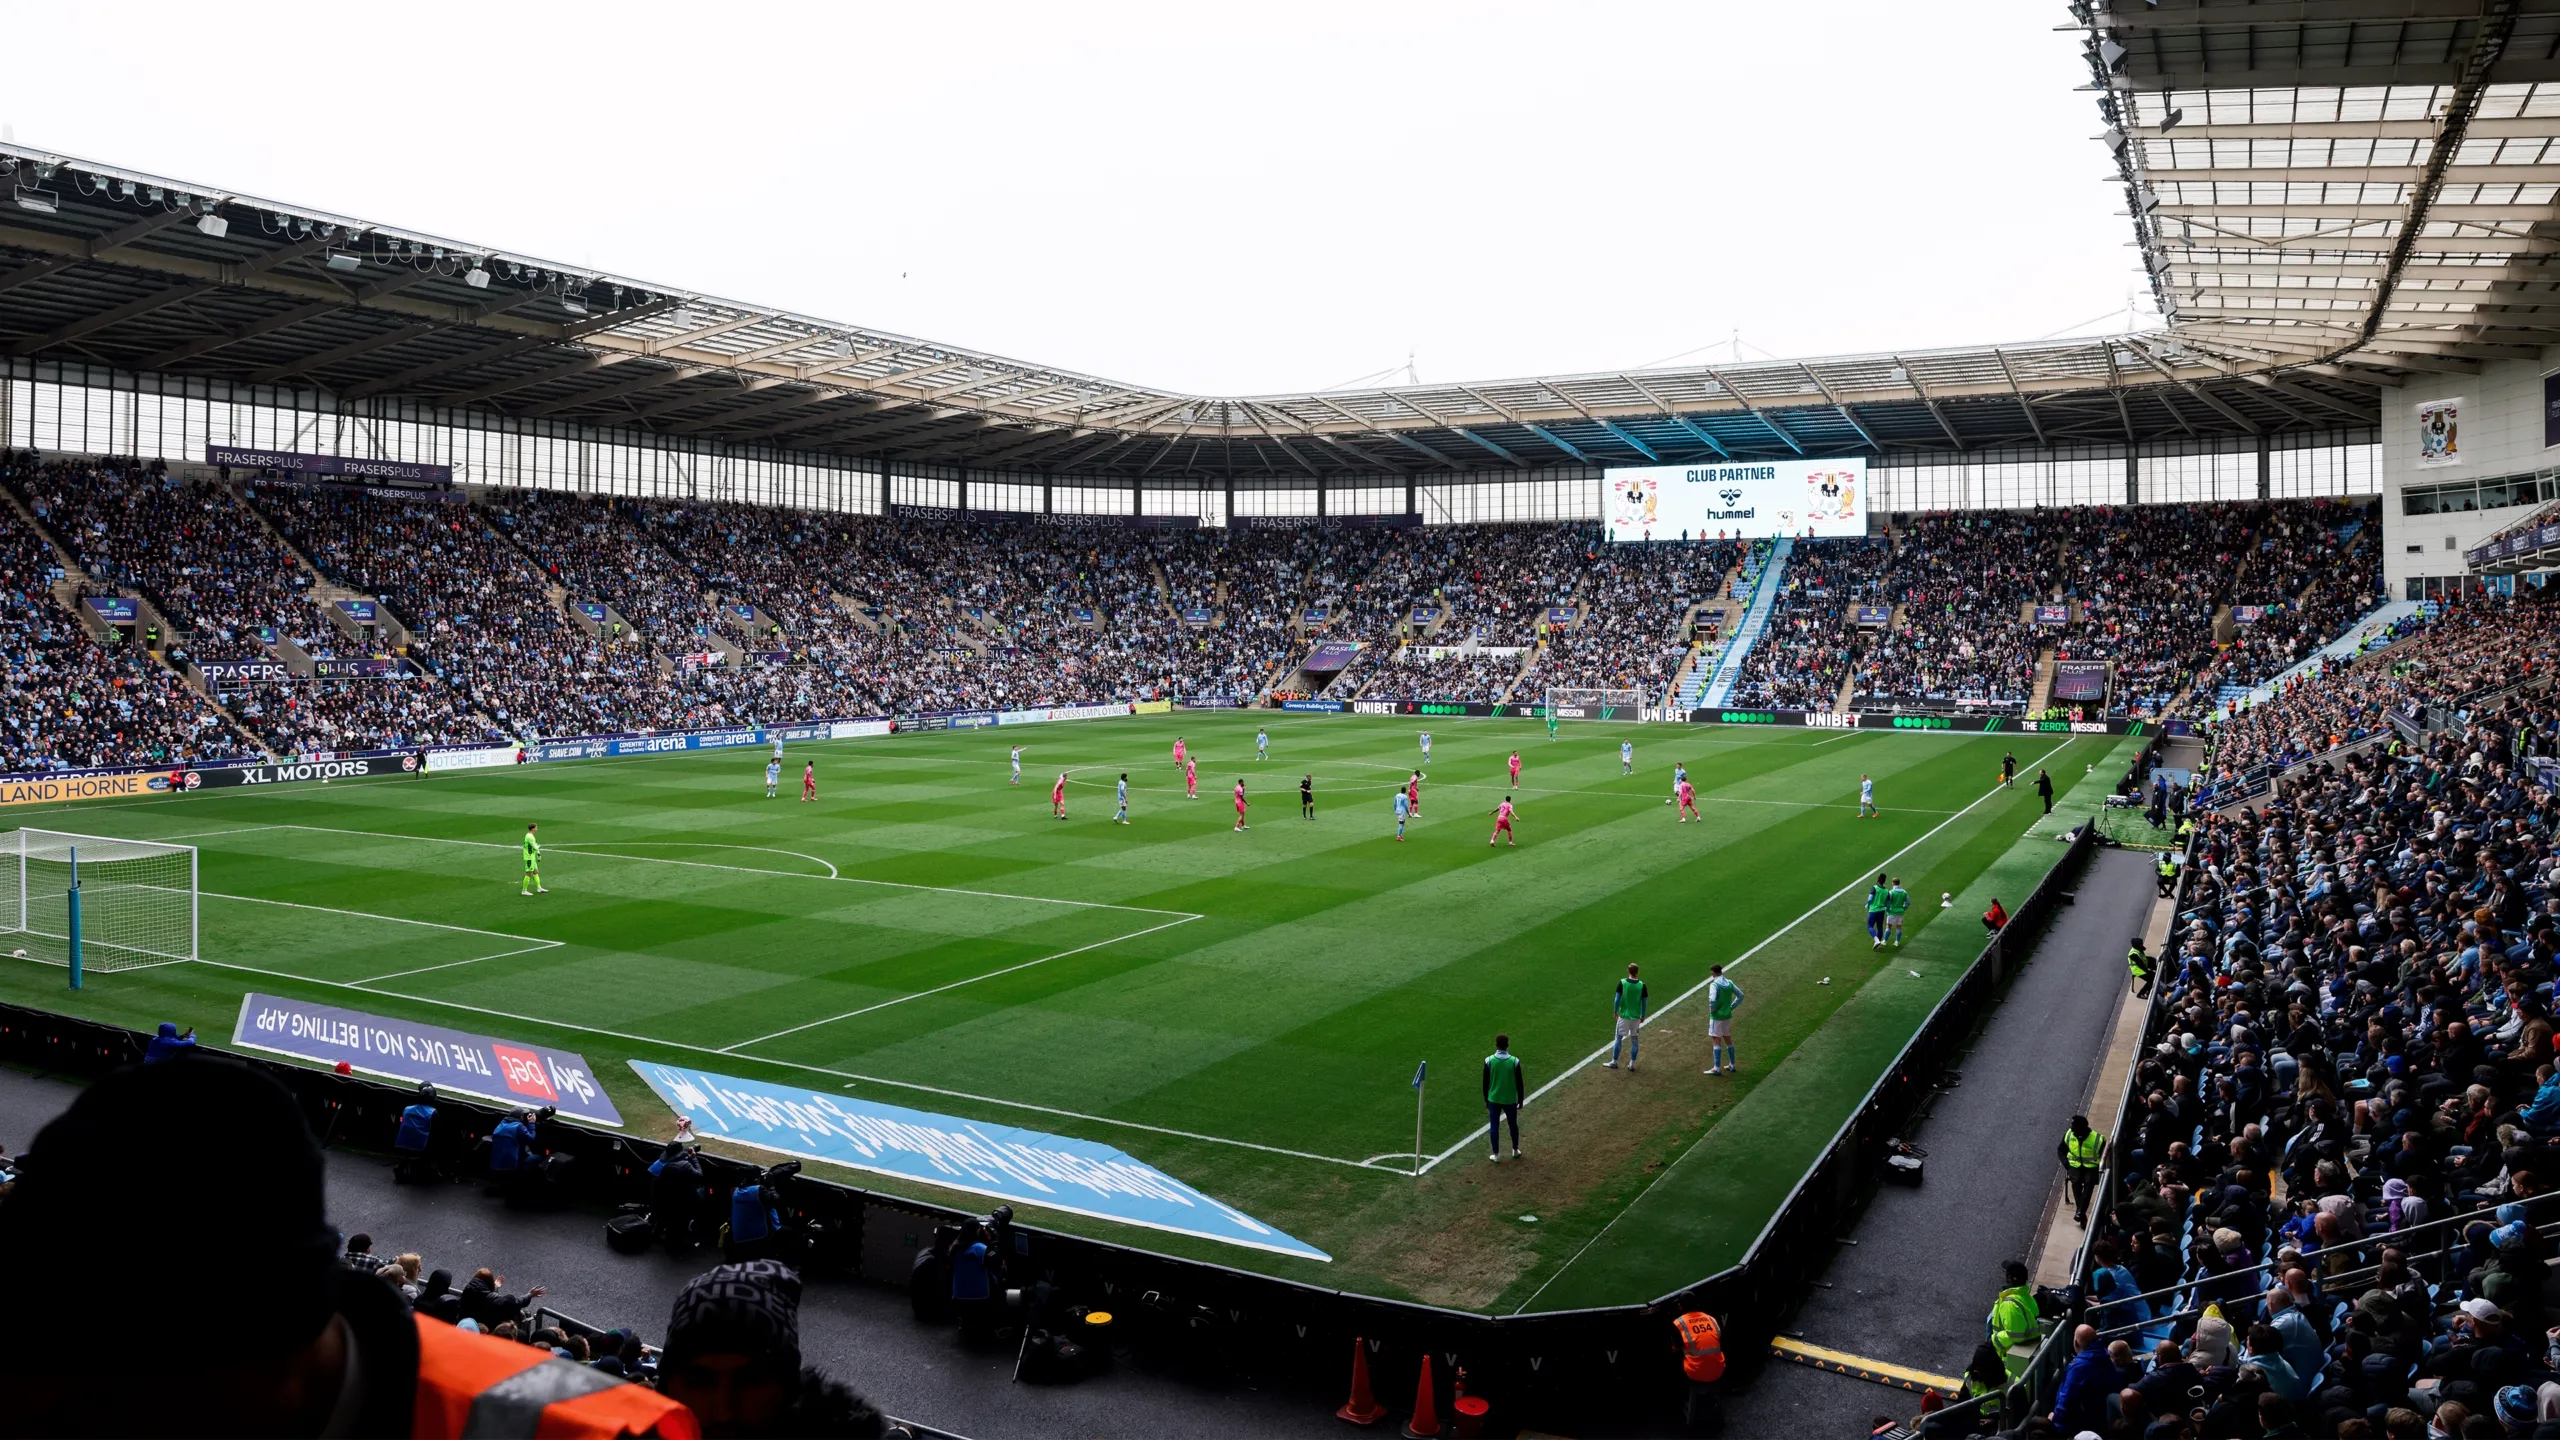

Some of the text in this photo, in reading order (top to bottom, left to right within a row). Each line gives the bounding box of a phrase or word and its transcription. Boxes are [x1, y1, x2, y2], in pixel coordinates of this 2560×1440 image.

[216, 451, 303, 469] FRASERSPLUS
[344, 462, 421, 478] FRASERSPLUS
[1686, 466, 1775, 483] CLUB PARTNER
[898, 506, 977, 522] FRASERSPLUS
[1034, 513, 1124, 527] FRASERSPLUS
[1707, 506, 1755, 520] hummel
[1250, 516, 1343, 529] FRASERSPLUS
[1324, 644, 1351, 652] FRASE
[200, 664, 286, 682] FRASERS
[1189, 695, 1236, 707] FRASERSPLUS
[1285, 702, 1306, 710] Coventry
[1353, 701, 1398, 714] UNIBET
[1053, 709, 1082, 720] GENESIS
[1082, 704, 1129, 718] EMPLOYMEN
[1520, 707, 1533, 716] THE
[1556, 708, 1585, 718] MISSION
[1641, 708, 1693, 722] UNBET
[1805, 712, 1862, 728] UNIBET
[2021, 721, 2107, 733] THE ZERO% MISSION
[699, 735, 723, 743] COVENTRY
[724, 730, 757, 744] arena
[785, 729, 811, 739] SHAVE.COM
[647, 735, 687, 751] arena
[548, 746, 582, 758] SHAVE.COM
[241, 760, 369, 785] XL MOTORS
[0, 777, 138, 803] LAND HORNE
[256, 1007, 596, 1105] sky bet THE UK'S NO.1 BETTING APP
[699, 1075, 1271, 1236] Coventry Building Society
[1692, 1323, 1713, 1334] 054
